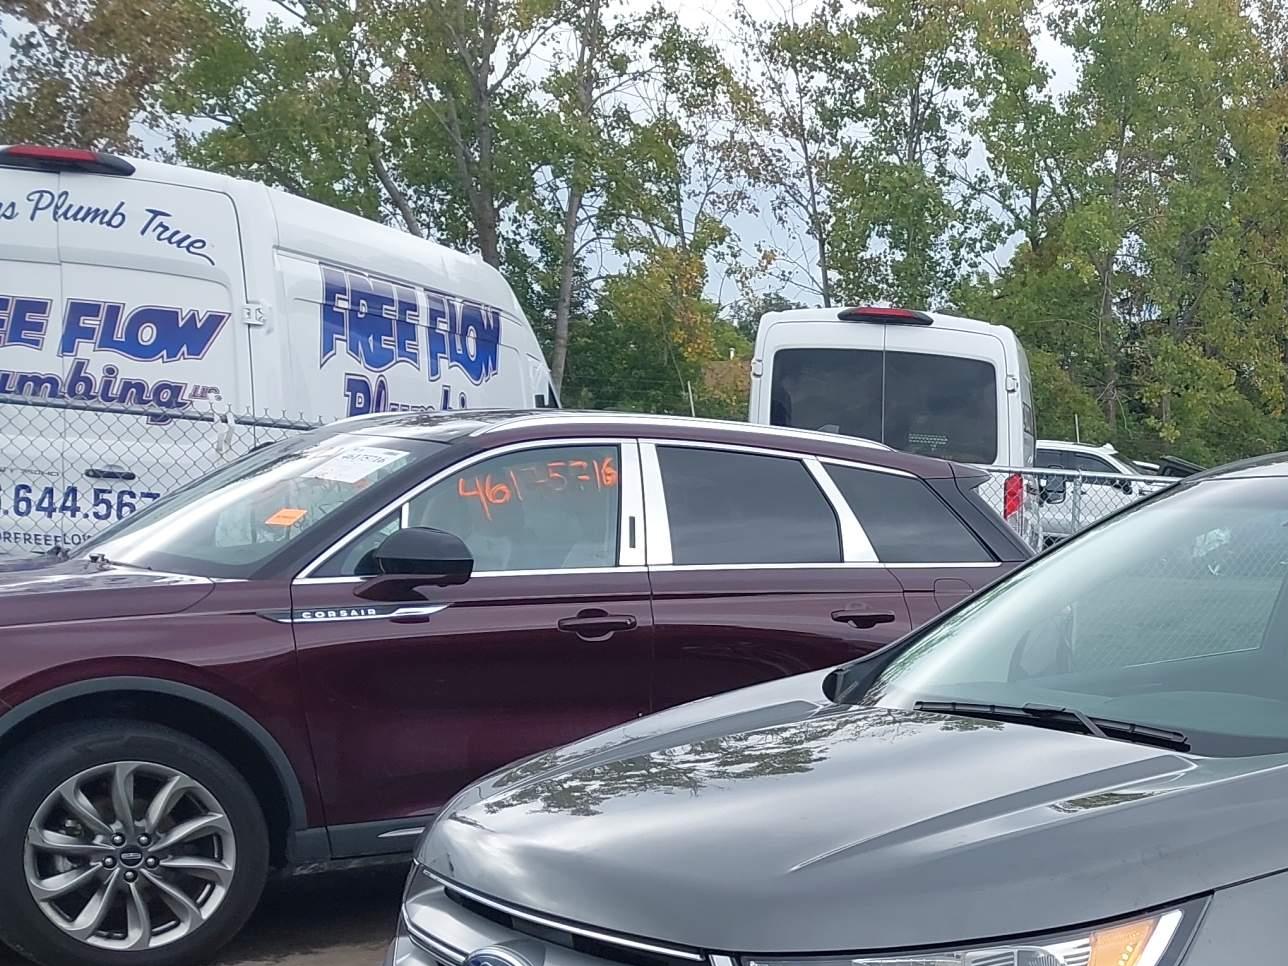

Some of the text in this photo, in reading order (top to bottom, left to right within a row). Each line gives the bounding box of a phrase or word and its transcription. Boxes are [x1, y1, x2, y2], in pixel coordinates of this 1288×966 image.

[26, 189, 126, 229] Plumb
[140, 208, 215, 266] True
[57, 297, 232, 363] FLOW
[319, 262, 502, 386] FREE FLOW
[0, 483, 161, 521] .644.56
[302, 608, 377, 619] CORSAIR
